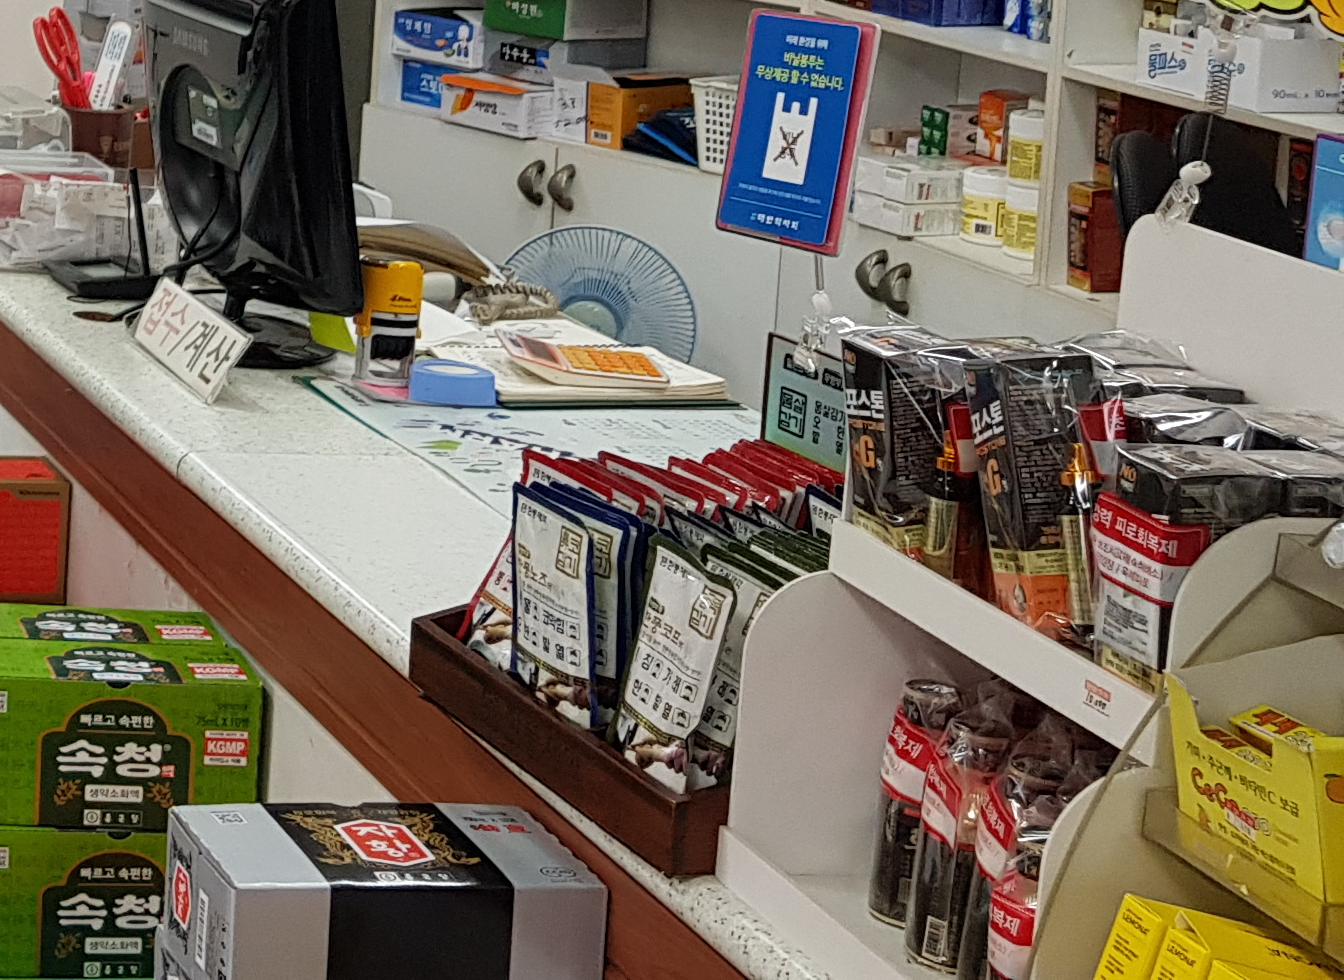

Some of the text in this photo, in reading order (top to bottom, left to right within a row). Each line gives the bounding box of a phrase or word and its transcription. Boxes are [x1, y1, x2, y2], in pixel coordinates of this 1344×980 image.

[783, 51, 826, 70] 비닐봉투는
[756, 65, 845, 91] 무상제공 할 수 없습니다.
[141, 293, 233, 386] 접수/계산
[844, 388, 885, 421] 포스톤
[972, 399, 1005, 445] 포스톤
[1114, 516, 1178, 559] 피로회복제
[80, 714, 155, 729] 빠르고 속편한
[56, 739, 163, 779] 속청
[206, 740, 246, 754] KGMP
[89, 788, 141, 800] 생약소화액
[1280, 796, 1300, 818] 보급
[80, 868, 153, 882] 빠르고 속편한
[56, 892, 163, 931] 속청
[1122, 911, 1151, 936] LEMONA
[88, 941, 140, 952] 생약소화액
[1166, 943, 1197, 968] LEMONA
